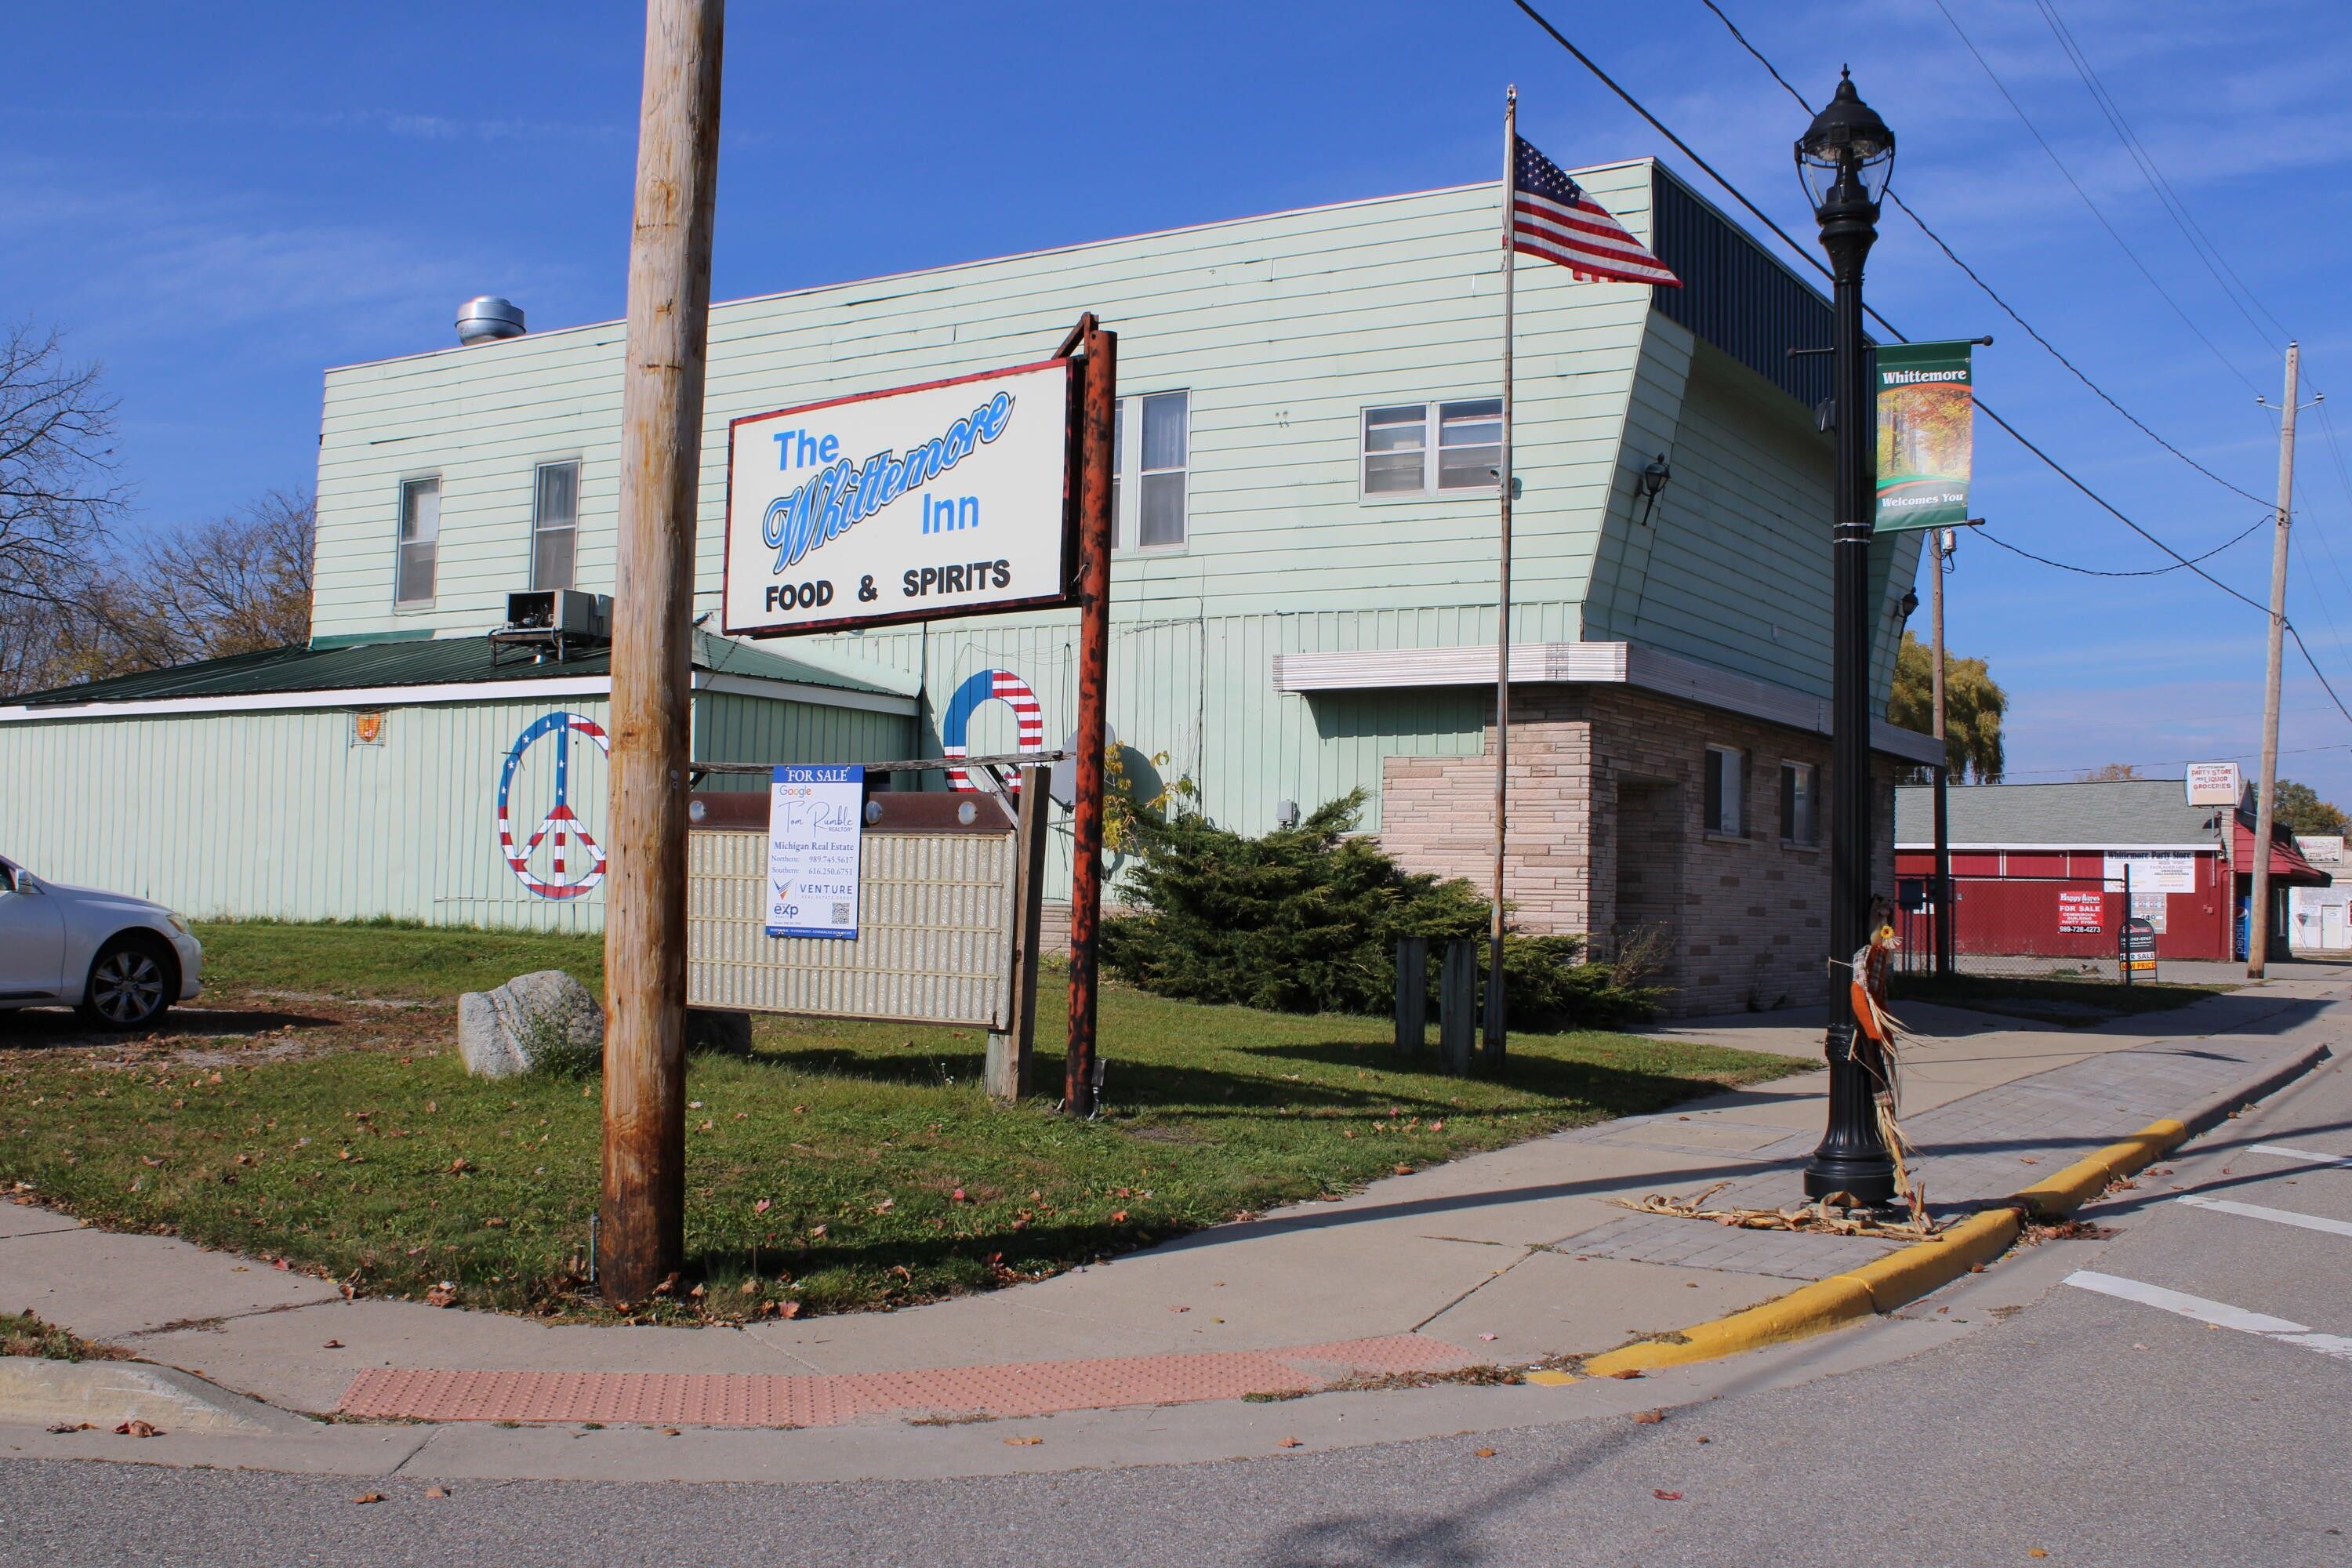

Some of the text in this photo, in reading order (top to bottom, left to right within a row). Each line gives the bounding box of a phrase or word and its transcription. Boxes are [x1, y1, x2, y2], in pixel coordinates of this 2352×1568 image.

[1882, 369, 1967, 384] Whittemore
[773, 429, 839, 470] The
[763, 390, 1016, 575] Whittemore
[1882, 493, 1963, 507] Welcomes You
[922, 493, 979, 535] Inn
[766, 560, 1011, 612] FOOD & SPIRITS
[788, 769, 848, 782] FOR SALE
[779, 785, 811, 798] Google
[778, 800, 853, 838] Tom Rumble
[774, 842, 854, 852] Michigan Real Estate
[2107, 851, 2148, 859] Whittemore
[2151, 851, 2170, 860] Party
[800, 884, 853, 895] VENTURE
[2060, 893, 2082, 902] Happy
[2236, 924, 2246, 954] pepsi
